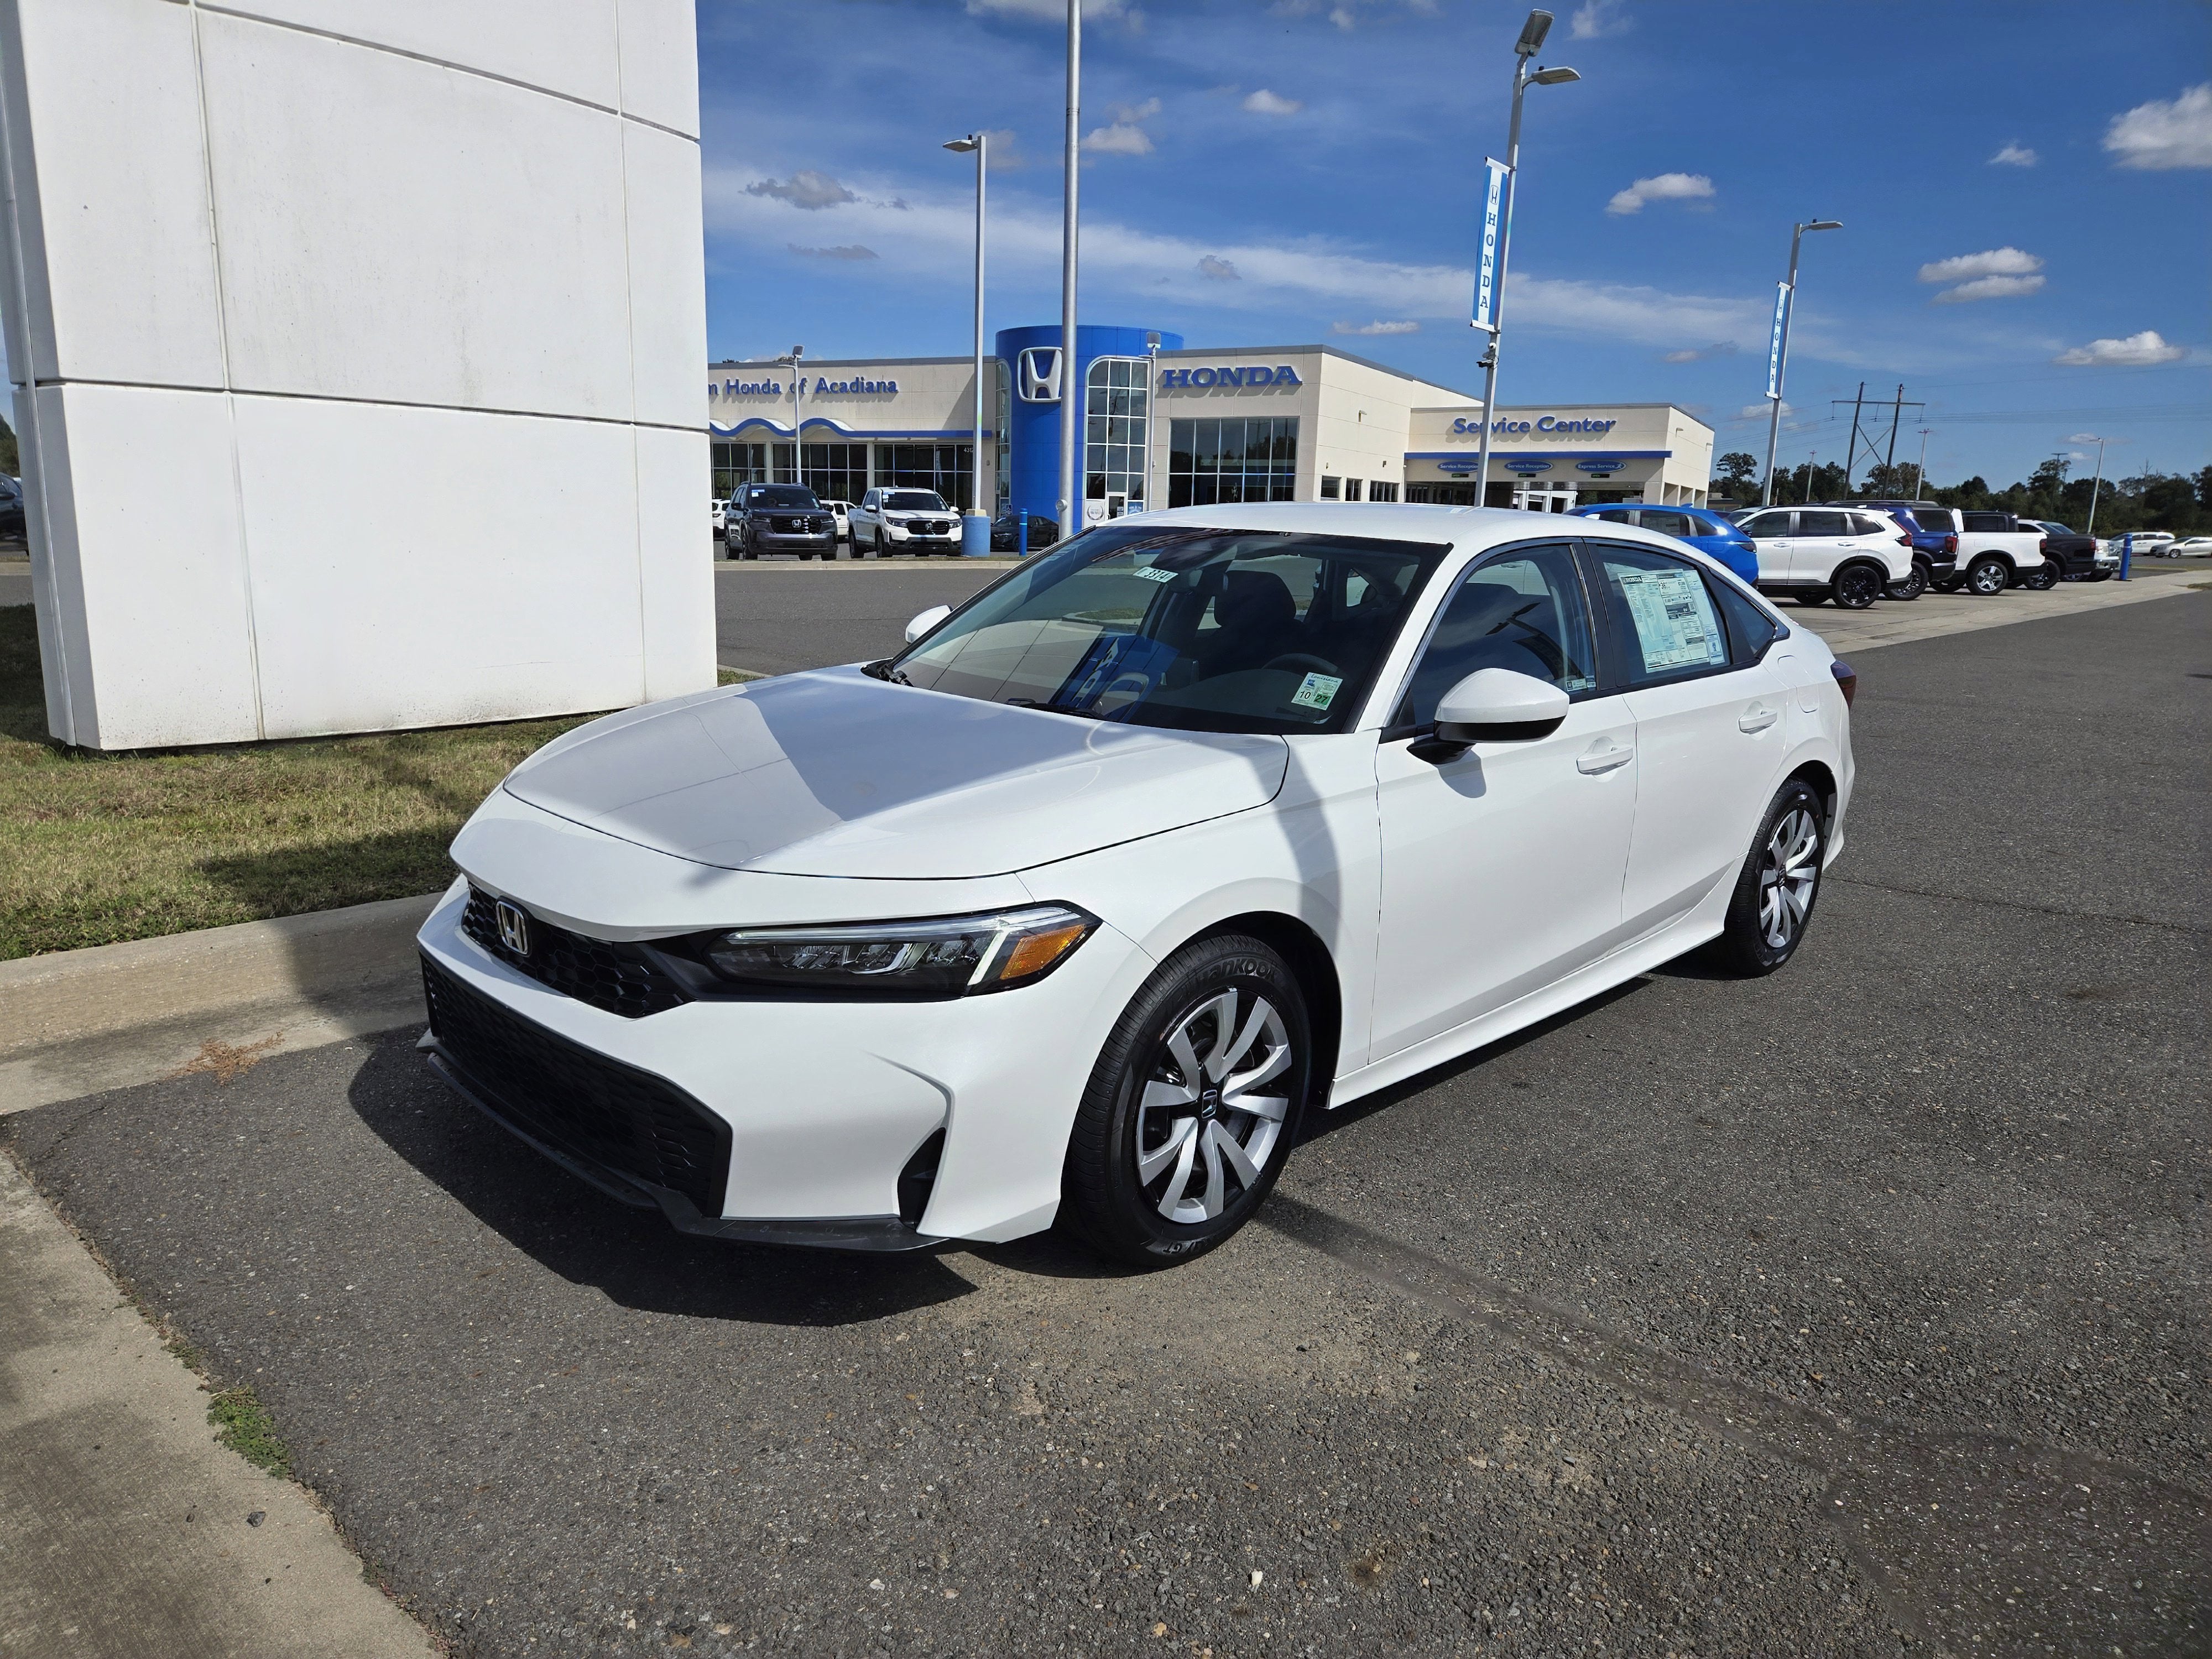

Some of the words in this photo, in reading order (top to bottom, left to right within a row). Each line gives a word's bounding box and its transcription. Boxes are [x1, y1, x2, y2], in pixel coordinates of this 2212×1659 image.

[1480, 212, 1496, 308] HONDA
[1771, 318, 1781, 382] HONDA
[1163, 366, 1303, 388] HONDA
[726, 378, 781, 395] Honda
[815, 377, 899, 394] Acadiana
[1537, 416, 1616, 432] Center
[1144, 570, 1171, 580] 3314
[1300, 690, 1311, 700] 10
[1313, 695, 1328, 703] 27
